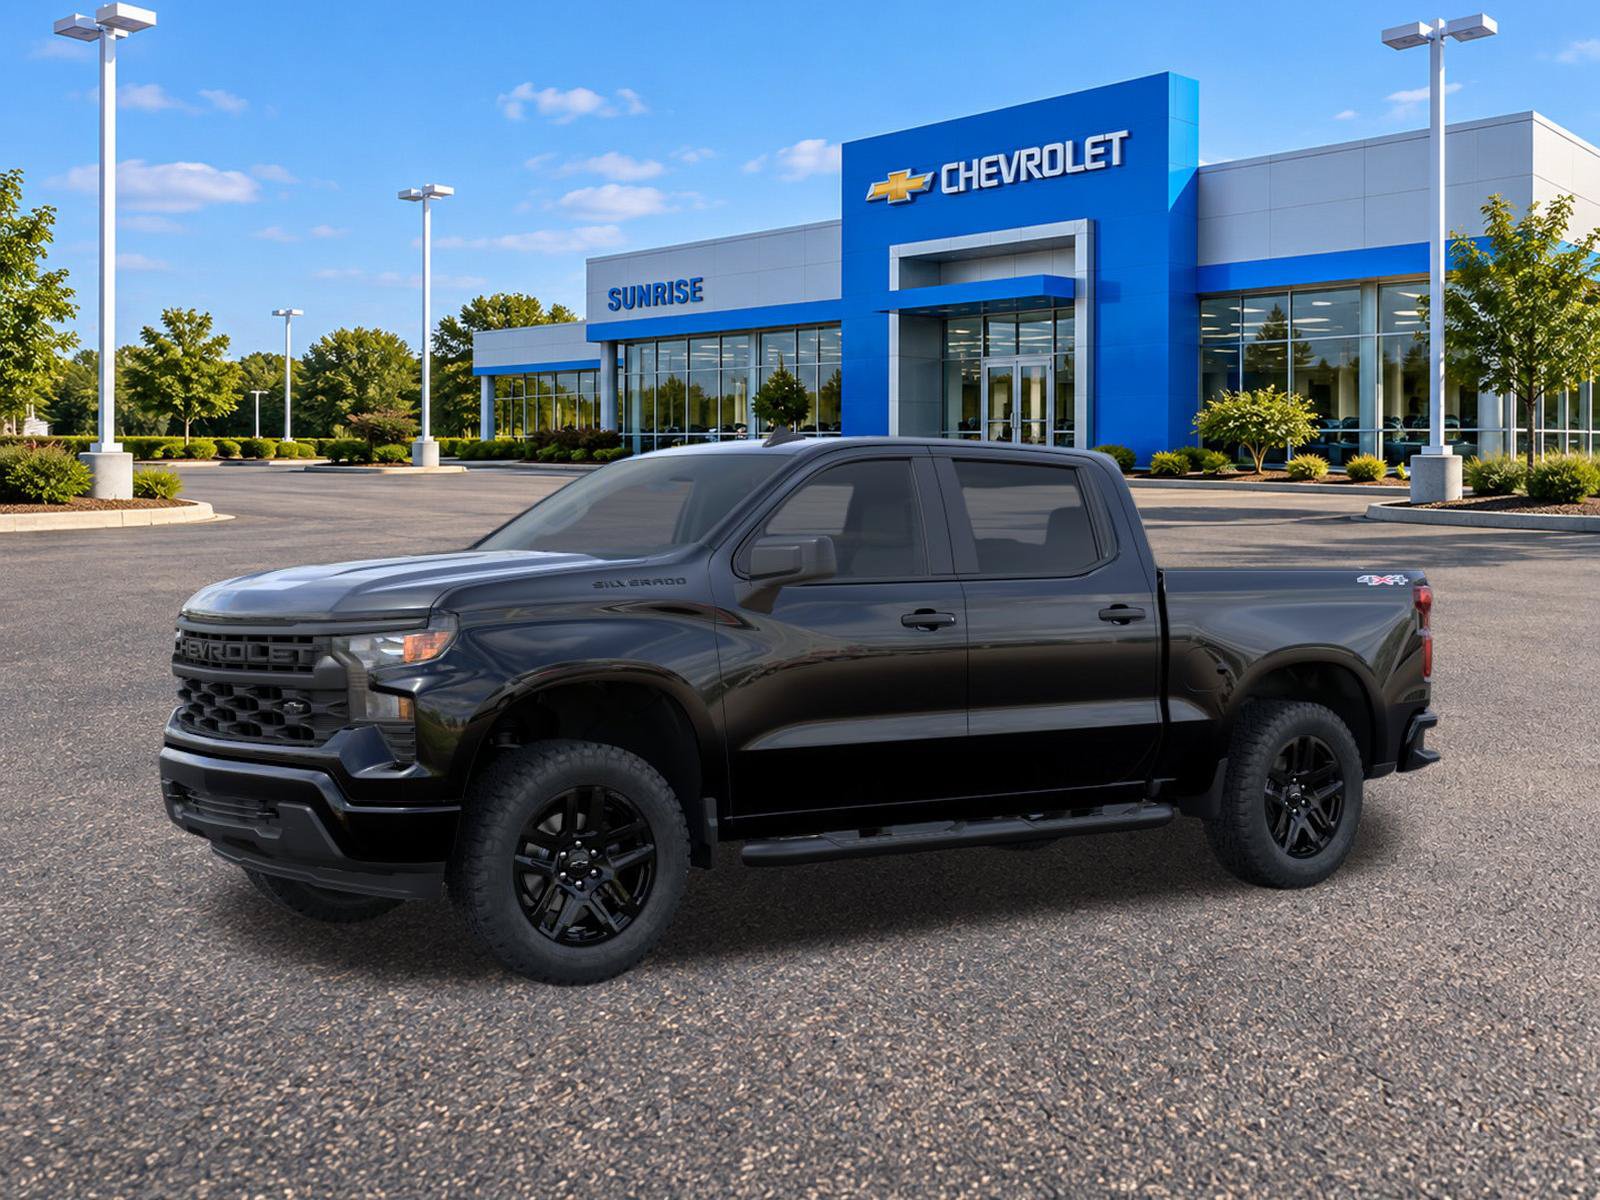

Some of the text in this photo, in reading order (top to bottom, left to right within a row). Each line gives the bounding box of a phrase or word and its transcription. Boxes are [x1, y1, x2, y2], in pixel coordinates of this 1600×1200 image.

[941, 129, 1129, 194] CHEVROLET
[607, 277, 704, 312] SUNRISE
[592, 577, 687, 589] SILVERADO
